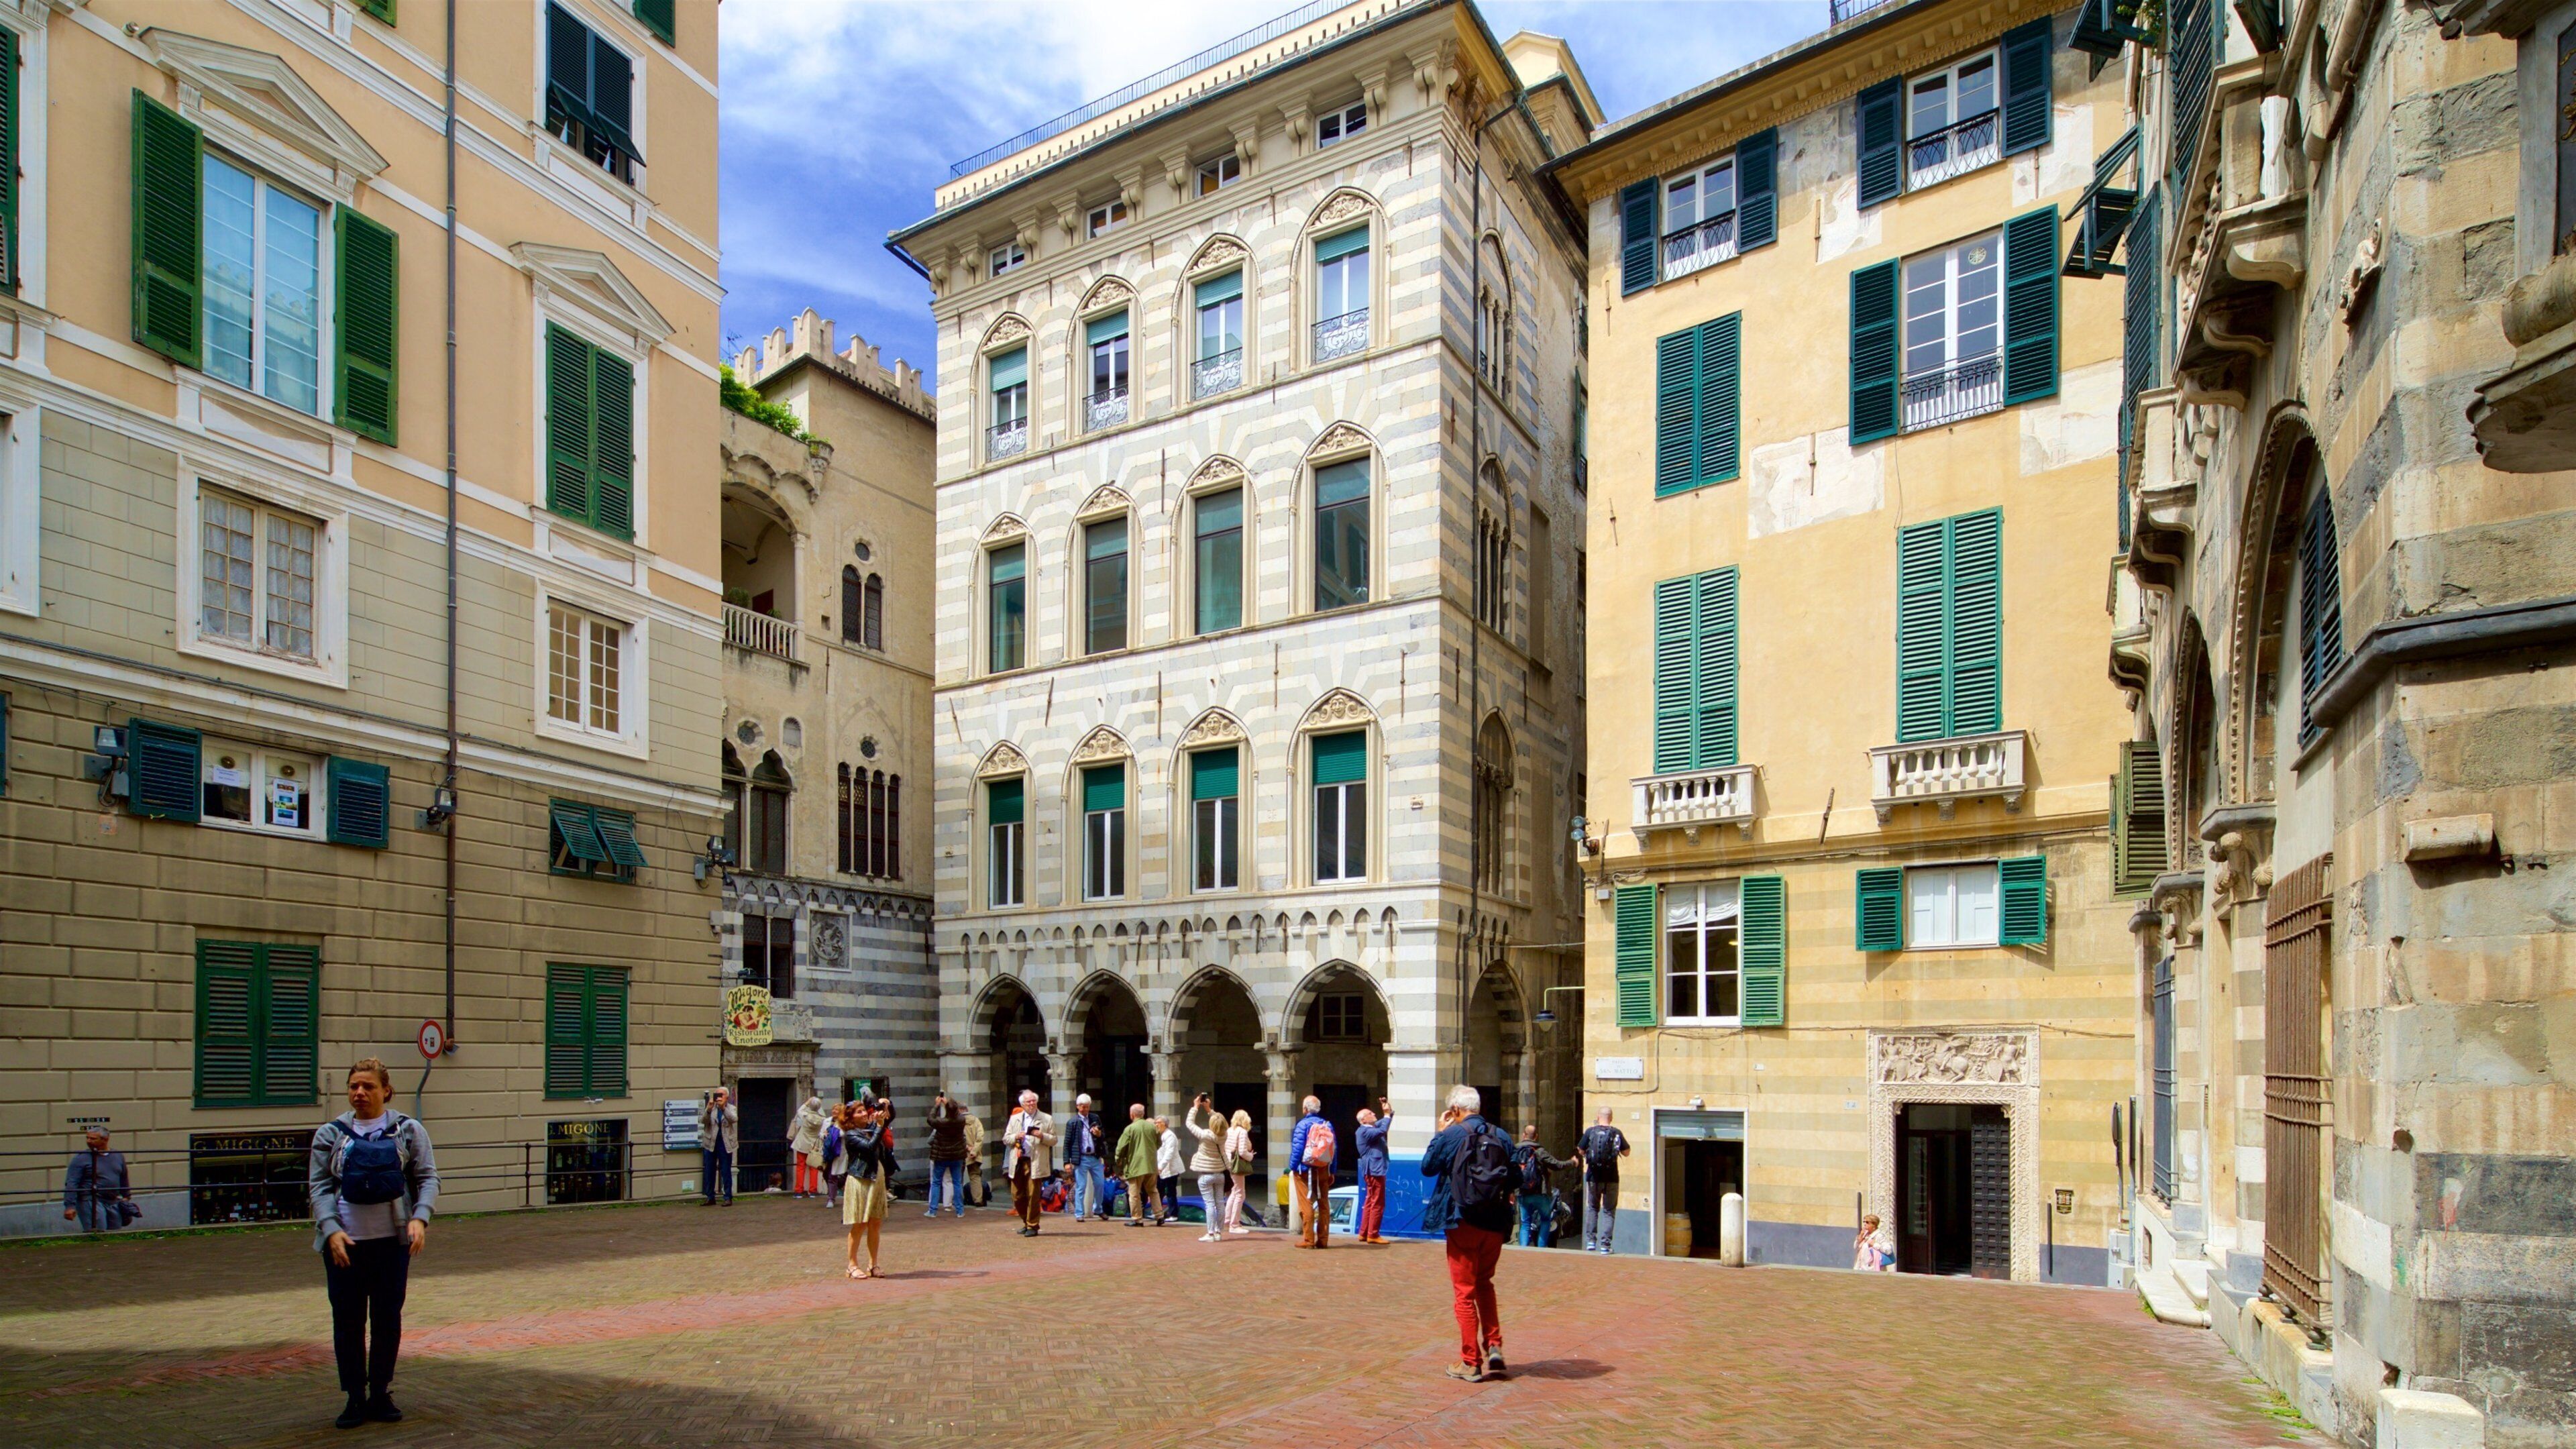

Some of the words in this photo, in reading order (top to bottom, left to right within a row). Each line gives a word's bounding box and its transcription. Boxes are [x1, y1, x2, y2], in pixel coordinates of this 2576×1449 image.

[729, 987, 768, 1009] Migone
[729, 1028, 771, 1036] Ristorante
[558, 1123, 610, 1135] MIGONE
[216, 1137, 295, 1149] MIGONE
